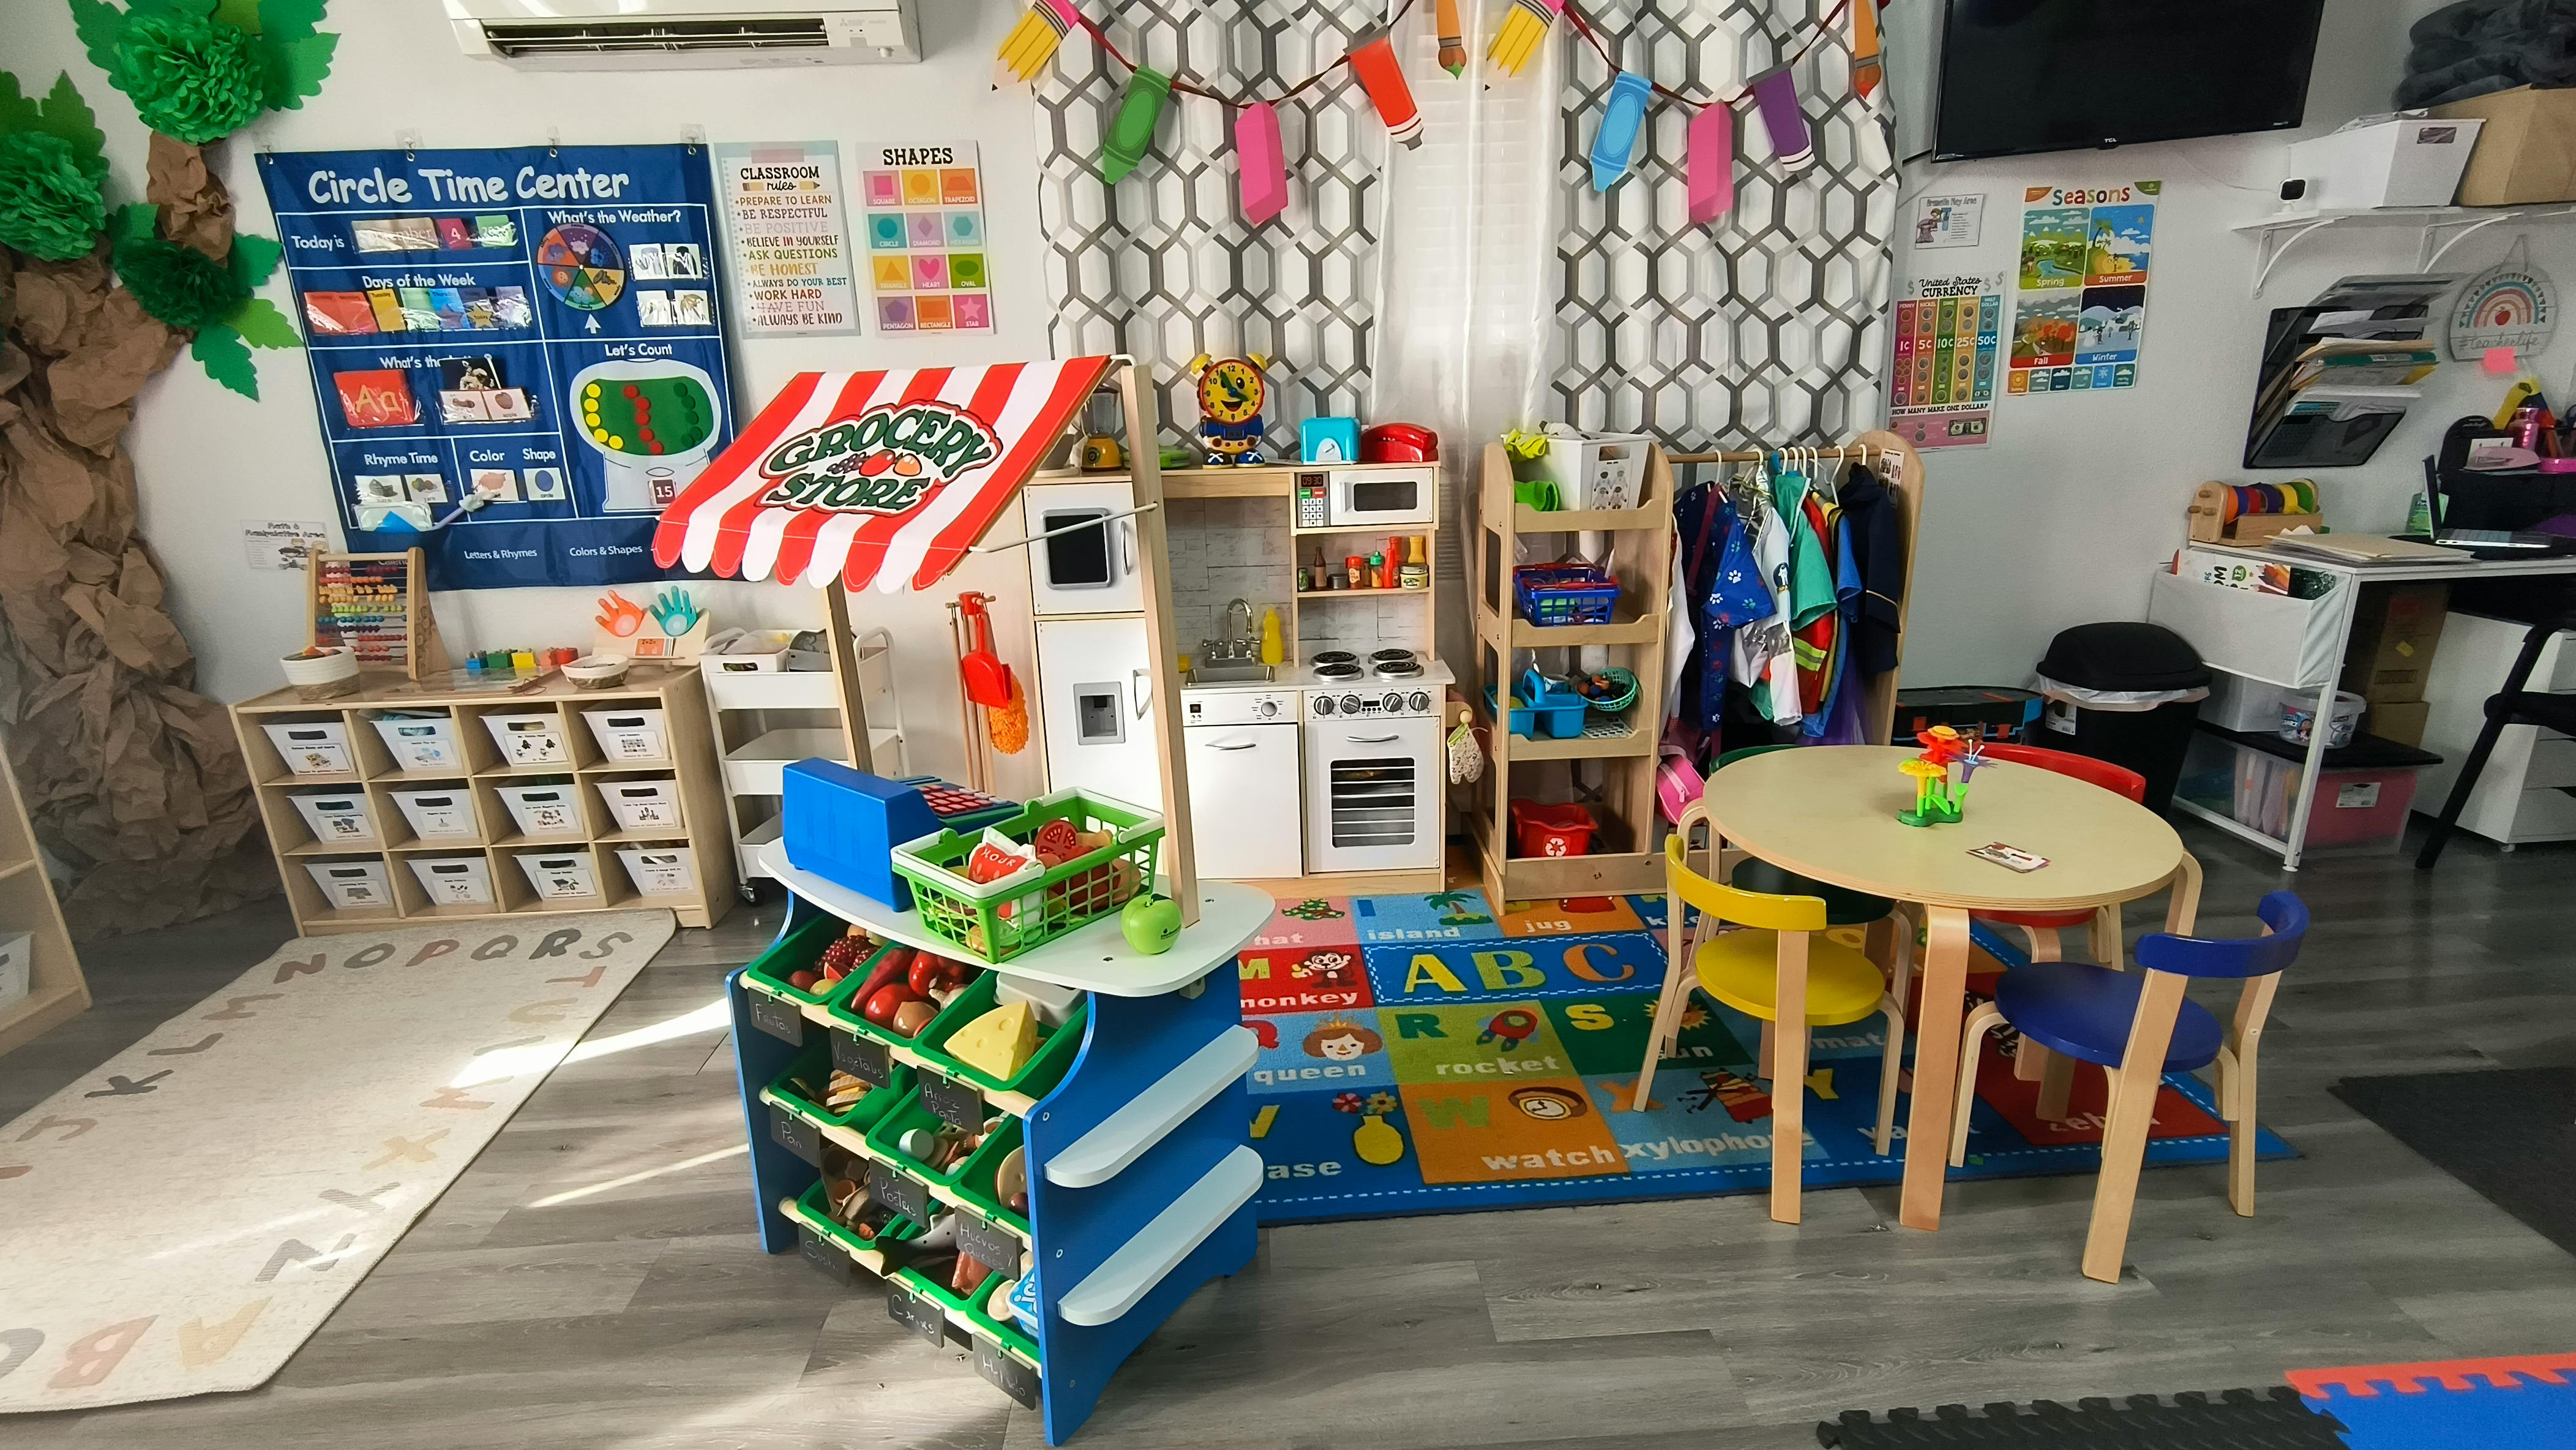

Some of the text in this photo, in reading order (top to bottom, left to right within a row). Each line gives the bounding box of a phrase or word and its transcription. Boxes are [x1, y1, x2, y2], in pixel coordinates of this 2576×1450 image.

[883, 147, 954, 166] SHAPES
[741, 166, 820, 179] CLASSROOM
[308, 165, 629, 205] Circle Time Center
[767, 181, 796, 191] rules
[740, 195, 832, 206] PREPARE TO LEARN
[2052, 187, 2130, 206] Seasons
[548, 209, 681, 224] What's the Weather?
[743, 208, 828, 220] BE RESPECTFUL
[451, 227, 461, 239] 4
[745, 222, 828, 235] BE POSITIVE
[291, 235, 345, 250] Today is
[747, 236, 780, 247] BELIEVE
[749, 248, 838, 260] ASK QUESTIONS
[751, 263, 818, 276] BE HONEST
[362, 273, 476, 290] Days of the Week
[752, 279, 784, 288] ALWAYS
[787, 279, 798, 287] DO
[827, 277, 847, 286] BEST
[1919, 276, 1982, 288] United States
[2037, 278, 2064, 288] Spring
[2099, 274, 2133, 284] Summer
[754, 288, 822, 301] WORK HARD
[1922, 285, 1979, 298] CURRENCY
[757, 301, 825, 313] HAVE FUN
[803, 314, 815, 325] BE
[604, 344, 673, 357] Let's Count
[2092, 353, 2117, 362] Winter
[380, 356, 422, 369] What's
[766, 407, 992, 478] GROCERY
[364, 453, 438, 467] Rhyme Time
[470, 449, 504, 462] Color
[523, 448, 556, 462] Shape
[656, 486, 673, 498] 15
[769, 471, 930, 509] STORE
[465, 550, 492, 560] Letters
[501, 549, 537, 560] Rhymes
[570, 545, 643, 557] Colors & Shapes
[1366, 925, 1461, 942] island
[1524, 919, 1572, 934] jug
[405, 939, 460, 966] P
[470, 934, 519, 961] Q
[529, 928, 582, 960] R
[579, 931, 634, 960] S
[1404, 943, 1635, 993] A B C
[755, 1003, 791, 1034] Frutas
[1564, 1004, 1614, 1031] S
[1395, 1012, 1448, 1039] R
[1254, 1061, 1366, 1086] queen
[1435, 1055, 1561, 1078] rocket
[925, 1083, 960, 1110] Arroz
[932, 1102, 962, 1127] Pasta
[1417, 1095, 1490, 1129] W
[781, 1122, 802, 1149] Pan
[1481, 1145, 1616, 1171] watch
[960, 1223, 1002, 1256] Huevos
